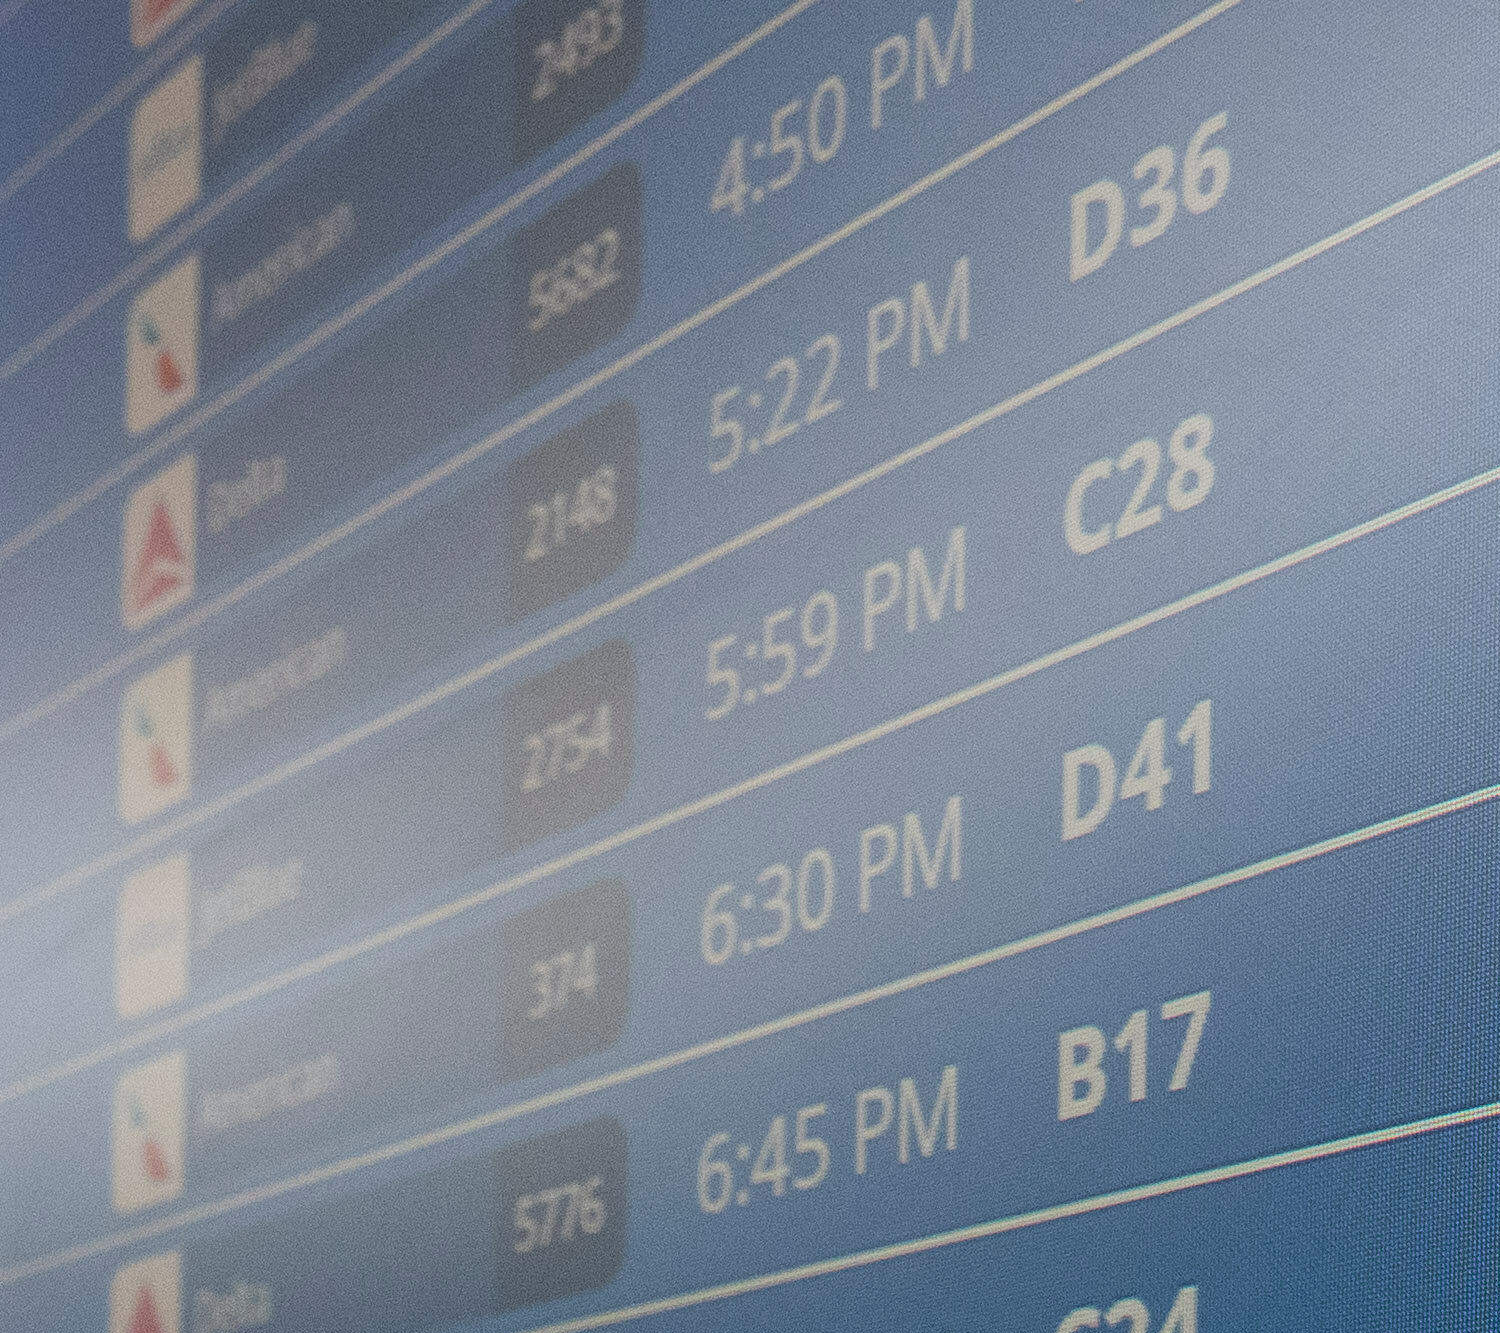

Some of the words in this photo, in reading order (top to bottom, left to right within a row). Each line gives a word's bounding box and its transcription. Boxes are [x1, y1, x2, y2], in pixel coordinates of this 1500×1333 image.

[527, 228, 621, 332] 5682
[711, 75, 846, 215] 4:50
[870, 0, 975, 130] PM
[526, 465, 618, 563] 2148
[711, 333, 843, 474] 5:22
[867, 255, 970, 390] PM
[1070, 111, 1231, 282] D36
[519, 704, 613, 793] 2754
[707, 590, 838, 720] 5:59
[862, 525, 966, 652] PM
[1064, 412, 1216, 556] C28
[528, 946, 598, 1021] 374
[703, 848, 835, 966] 6:30
[858, 796, 963, 913] PM
[1061, 702, 1211, 841] D41
[514, 1178, 606, 1255] 5776
[700, 1104, 832, 1214] 6:45
[855, 1065, 958, 1175] PM
[1058, 990, 1211, 1121] B17
